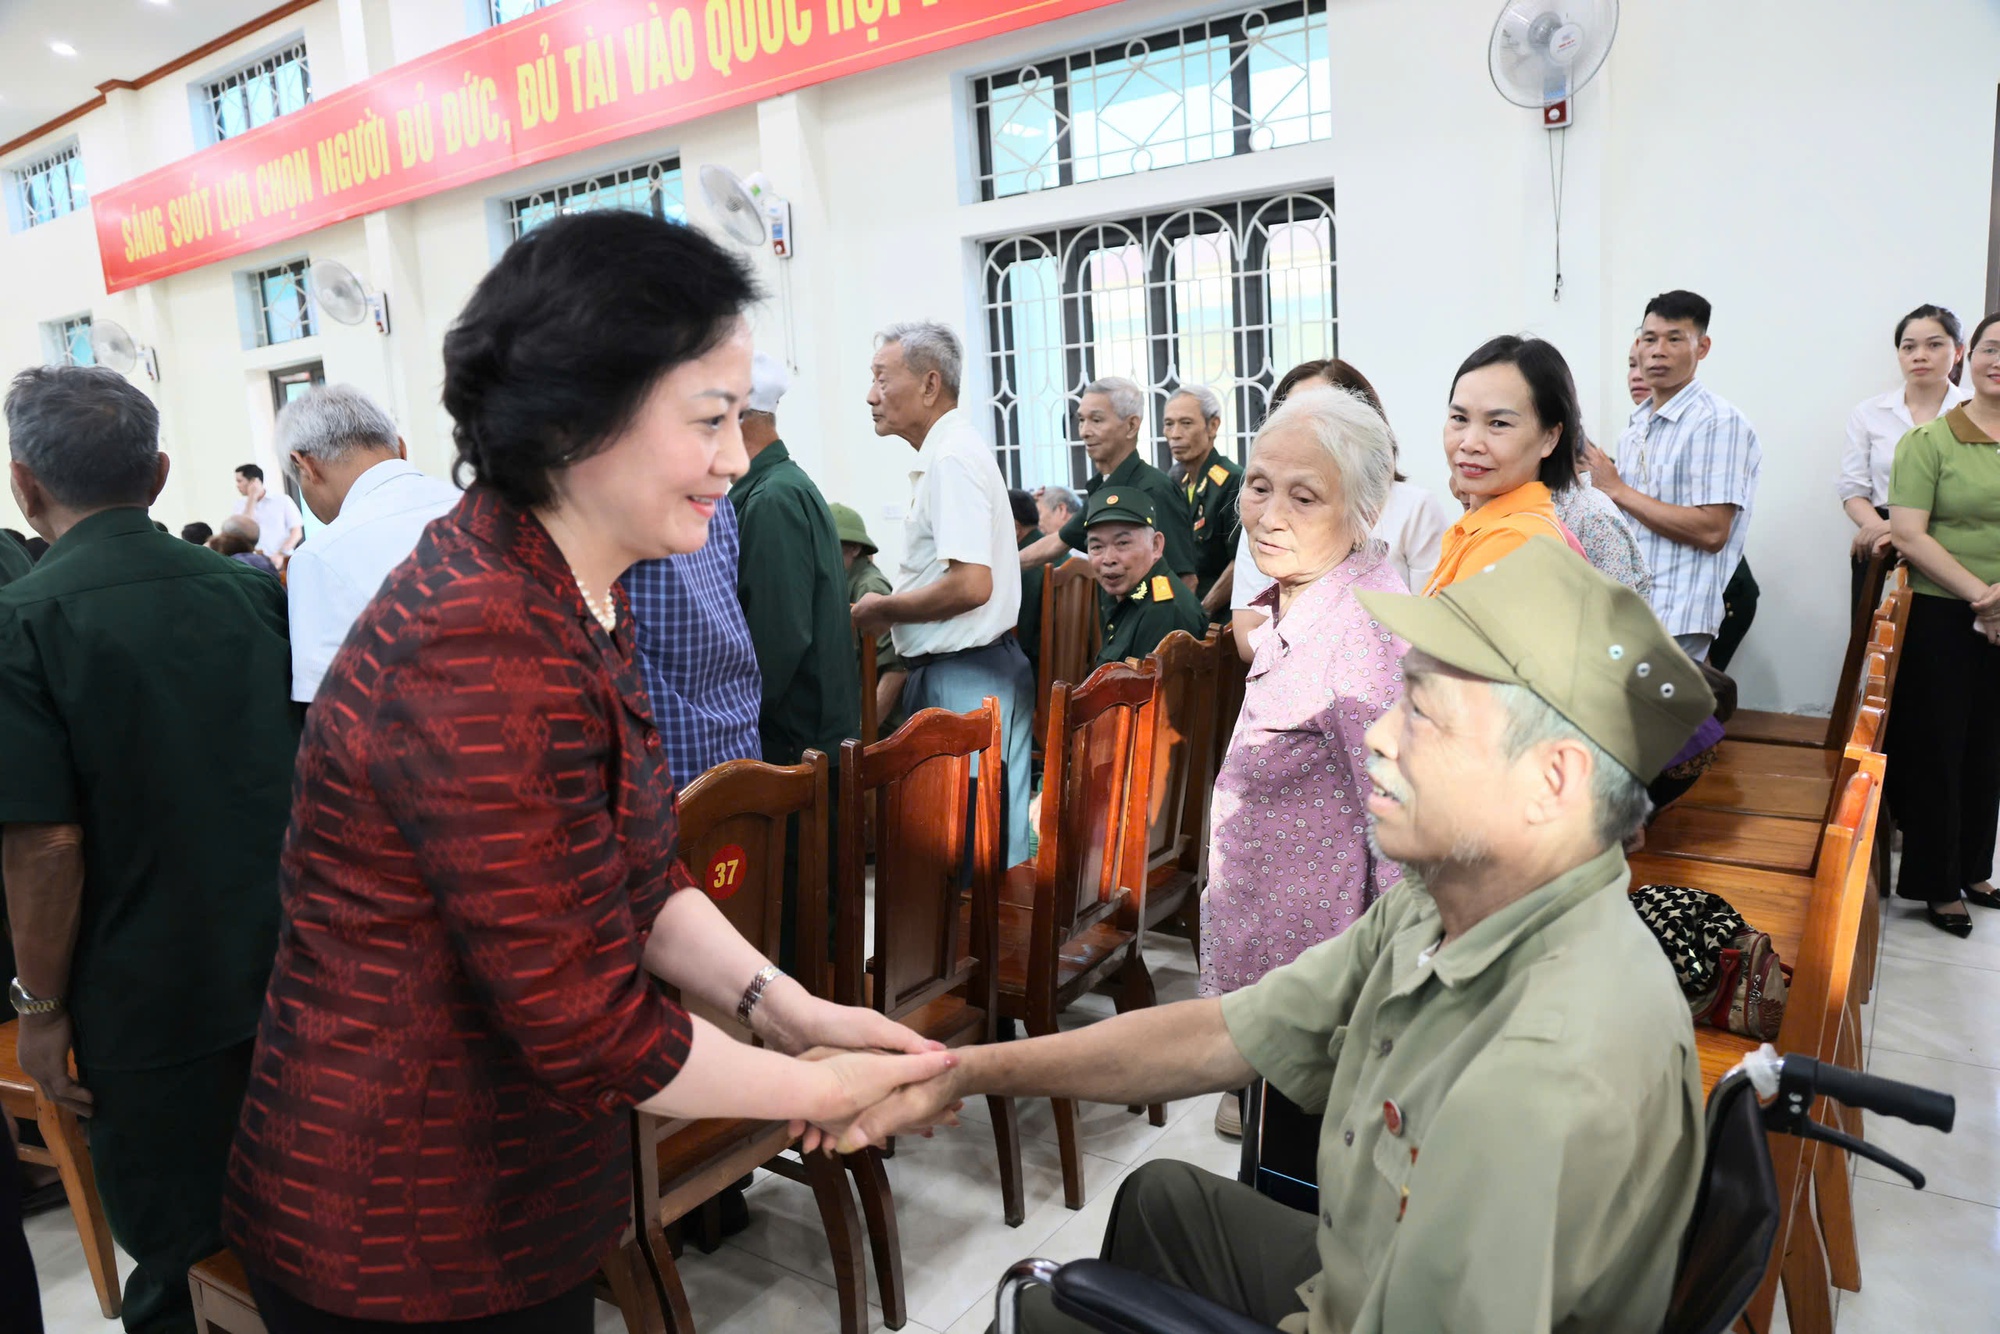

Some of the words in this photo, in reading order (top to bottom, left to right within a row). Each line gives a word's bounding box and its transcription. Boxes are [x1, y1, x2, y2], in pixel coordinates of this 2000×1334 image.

[122, 203, 167, 263] SÁNG
[256, 147, 313, 220] CHỌN
[317, 106, 391, 196] NGƯỜI
[442, 70, 511, 155] ĐỨC,
[516, 33, 559, 130] ĐỦ
[564, 25, 619, 114] TÀI
[624, 2, 695, 95] VÀO
[714, 859, 739, 888] 37
